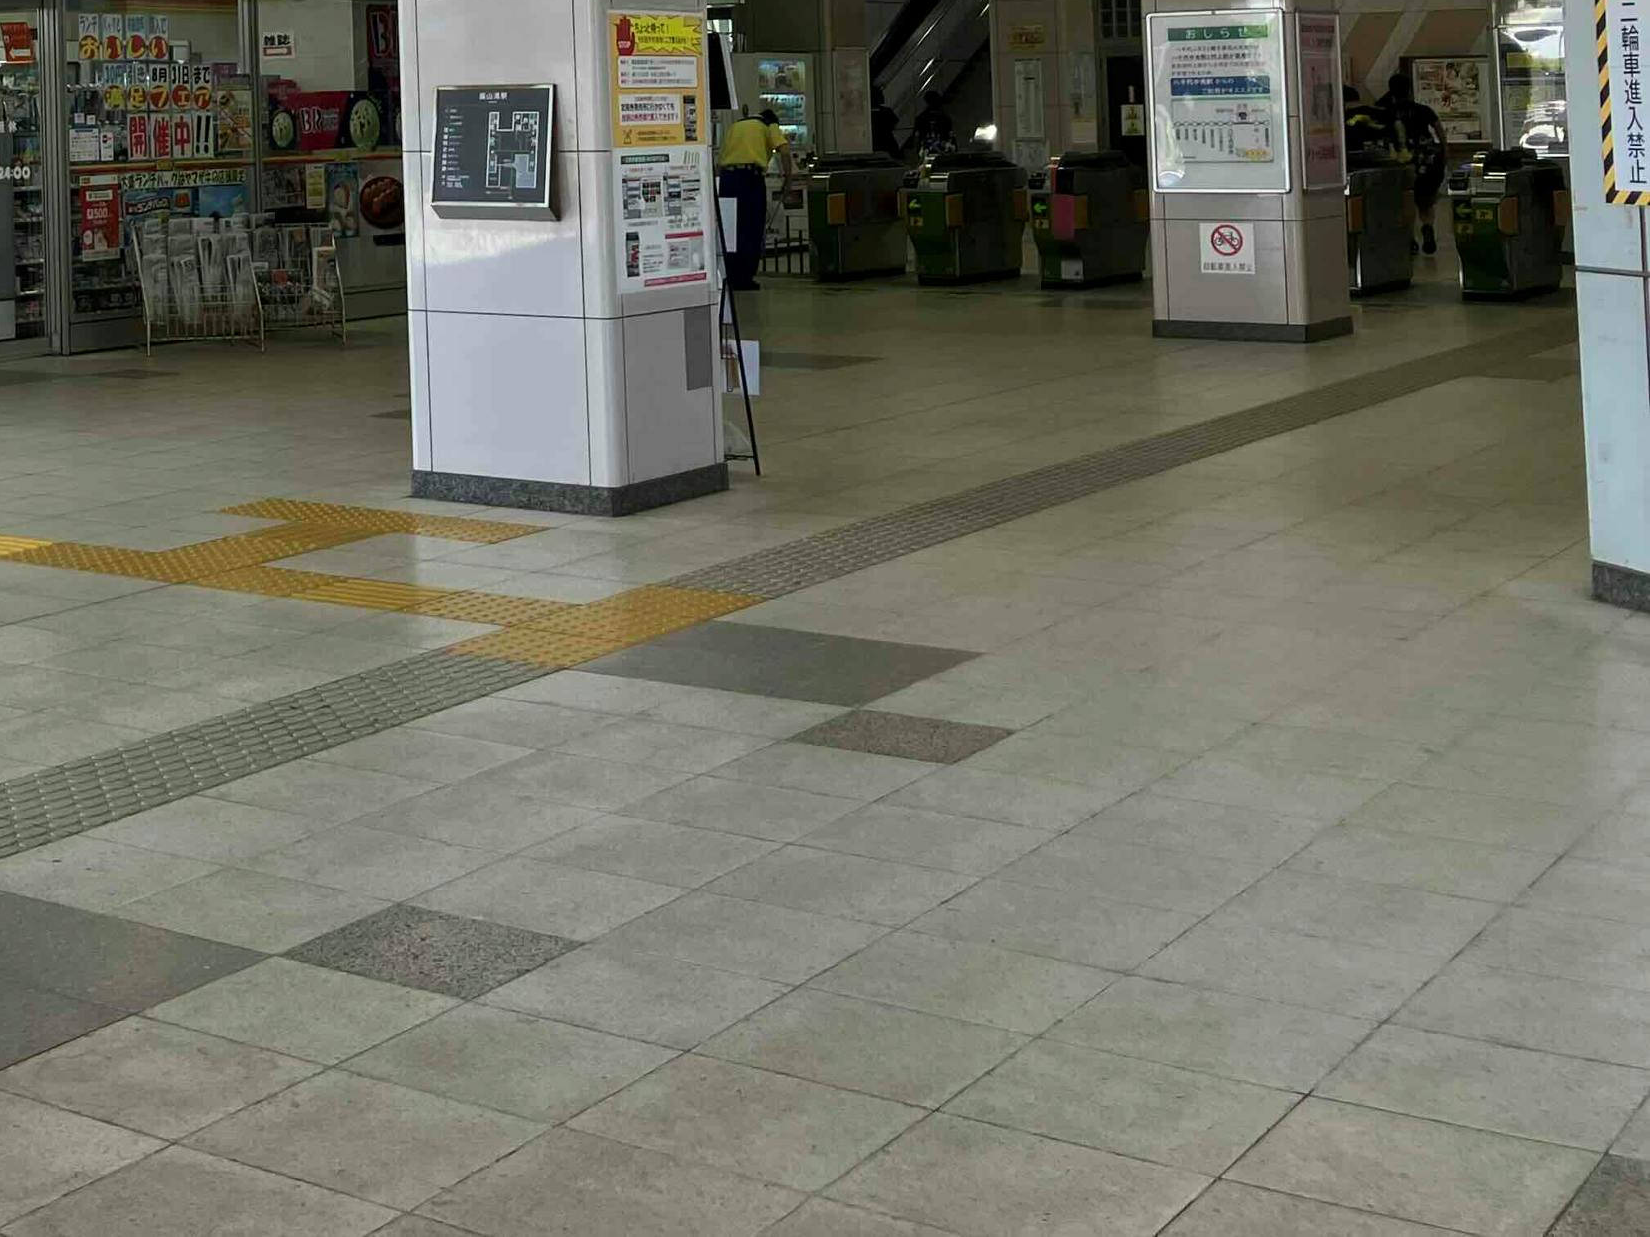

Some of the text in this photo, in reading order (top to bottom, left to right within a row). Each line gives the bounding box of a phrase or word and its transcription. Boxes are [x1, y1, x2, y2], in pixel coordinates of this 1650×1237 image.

[1620, 1, 1648, 185] 二輪車進入禁止
